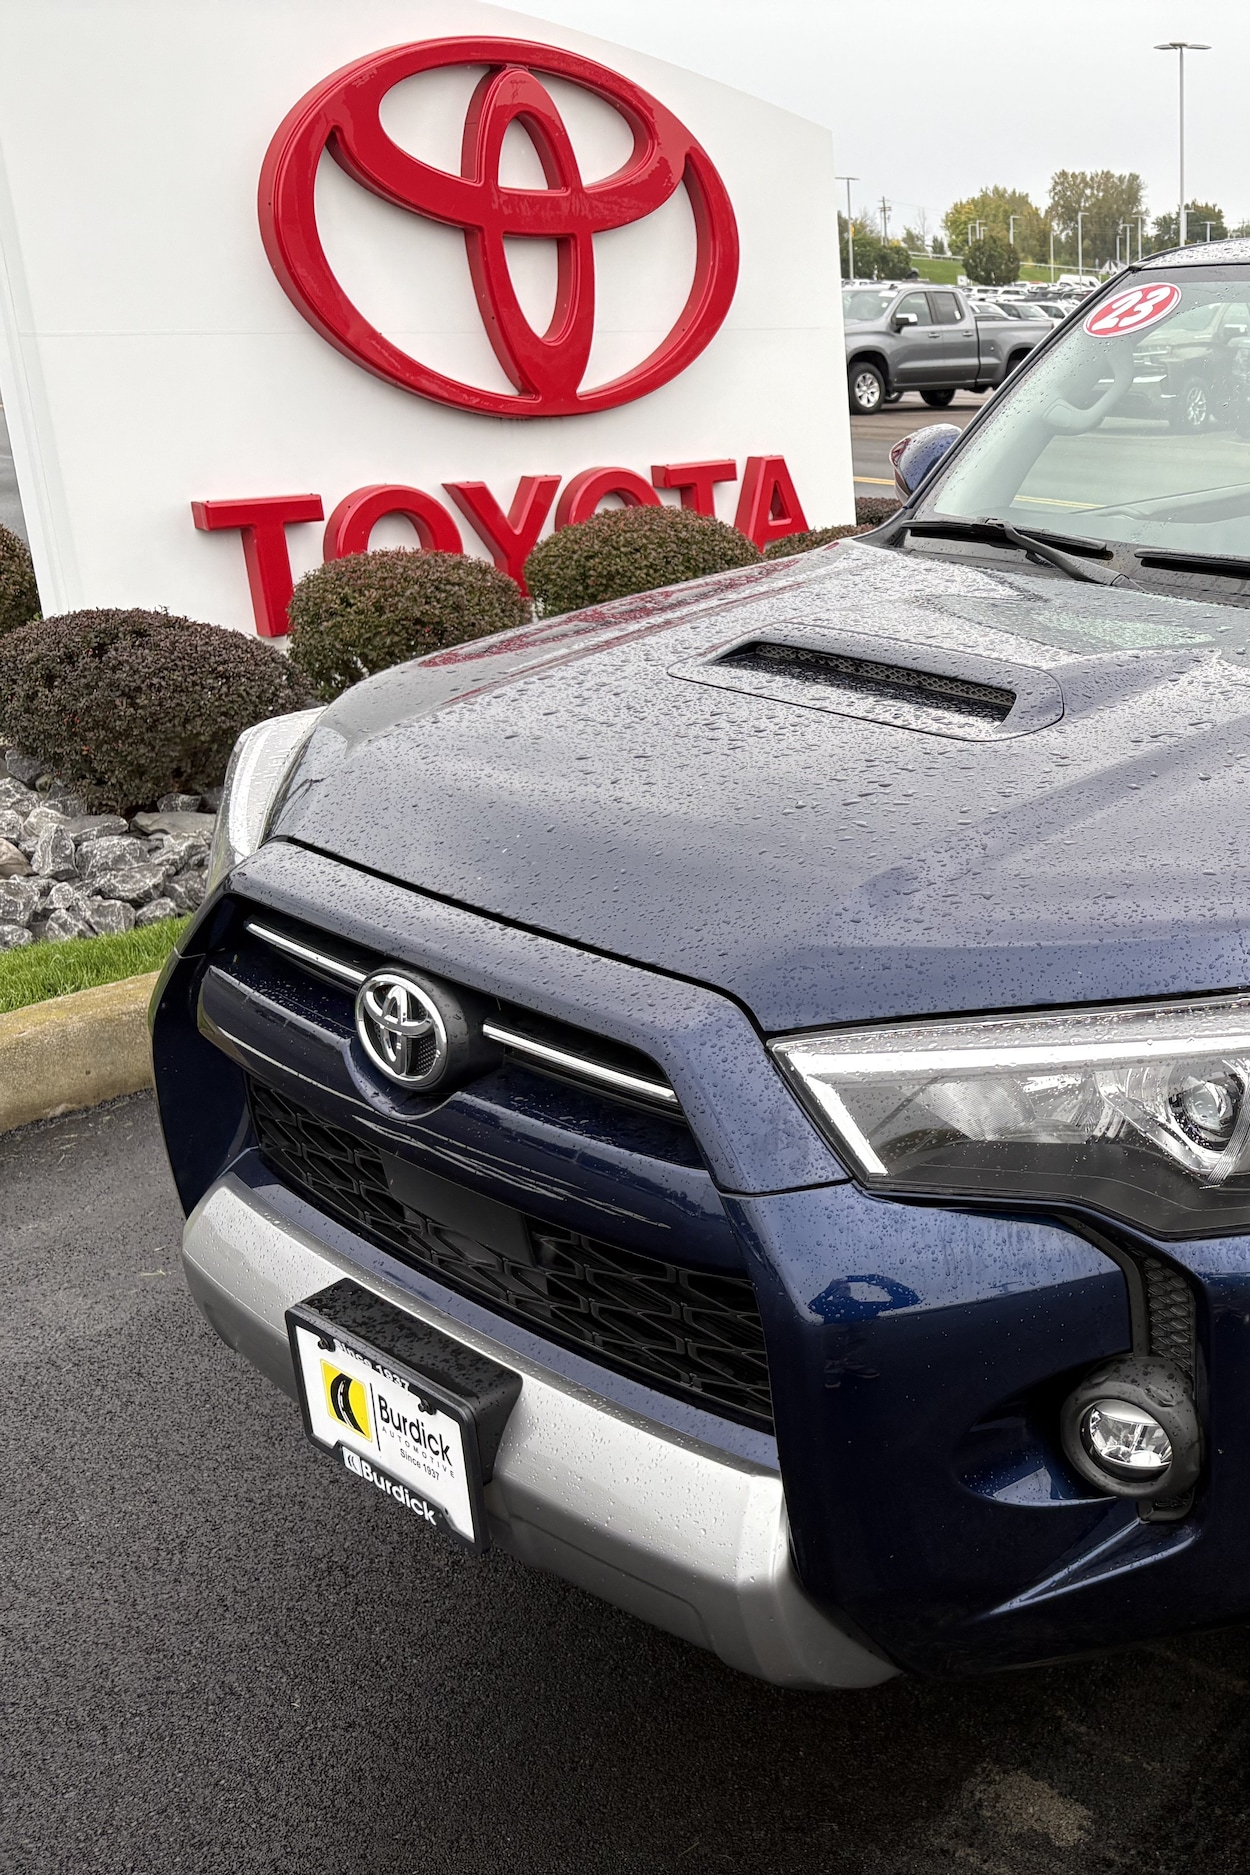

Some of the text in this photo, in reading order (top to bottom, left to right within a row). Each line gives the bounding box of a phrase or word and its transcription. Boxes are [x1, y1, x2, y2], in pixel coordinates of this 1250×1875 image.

[1090, 286, 1172, 331] 23
[191, 454, 810, 638] TOYOTA
[376, 1364, 410, 1392] 1937
[378, 1394, 453, 1467] Burdick
[382, 1426, 454, 1479] AUTOMOTIVE
[400, 1448, 440, 1480] Since 1937
[360, 1461, 437, 1526] Burdick
